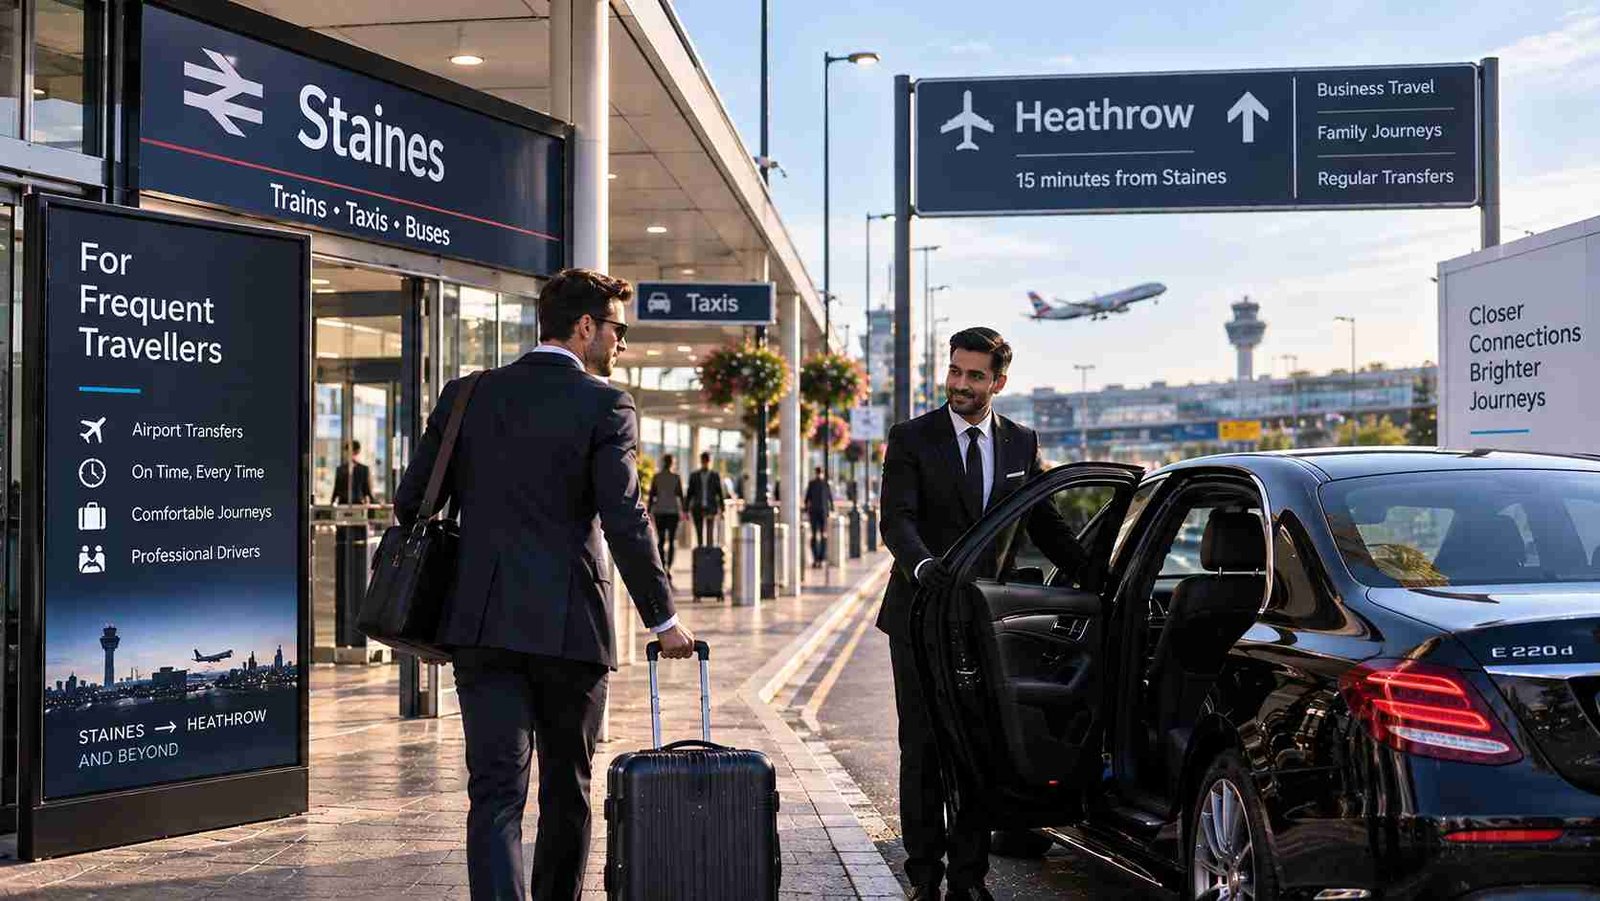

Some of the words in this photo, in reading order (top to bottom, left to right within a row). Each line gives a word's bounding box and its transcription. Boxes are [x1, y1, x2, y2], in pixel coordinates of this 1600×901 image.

[1318, 82, 1384, 96] Business
[1388, 79, 1434, 94] Travel
[1017, 98, 1194, 132] Heathrow
[297, 85, 444, 182] Staines
[1318, 125, 1367, 141] Family
[1372, 124, 1442, 140] Journeys
[1017, 172, 1034, 188] 15
[1041, 172, 1110, 187] minutes
[1115, 170, 1157, 185] from
[1163, 169, 1226, 185] Staines
[1319, 171, 1378, 188] Regular
[1382, 169, 1453, 184] Transfers
[270, 183, 328, 218] Trains
[346, 201, 387, 231] Taxis
[406, 215, 449, 245] Buses
[81, 242, 132, 275] For
[79, 285, 214, 326] Frequent
[687, 293, 738, 312] Taxis
[1470, 304, 1524, 325] Closer
[79, 327, 222, 363] Travellers
[1470, 325, 1581, 353] Connections
[1471, 360, 1541, 384] Brighter
[1470, 391, 1545, 412] Journeys
[133, 422, 181, 439] Airport
[185, 424, 243, 438] Transfers
[132, 464, 152, 478] On
[156, 465, 192, 480] Time,
[197, 465, 231, 481] Every
[235, 465, 264, 478] Time
[132, 506, 214, 521] Comfortable
[218, 506, 272, 521] Journeys
[132, 546, 212, 563] Professional
[218, 545, 260, 559] Drivers
[80, 724, 144, 744] STAINES
[188, 710, 266, 730] HEATHROW
[79, 751, 112, 768] AND
[119, 743, 178, 763] BEYOND
